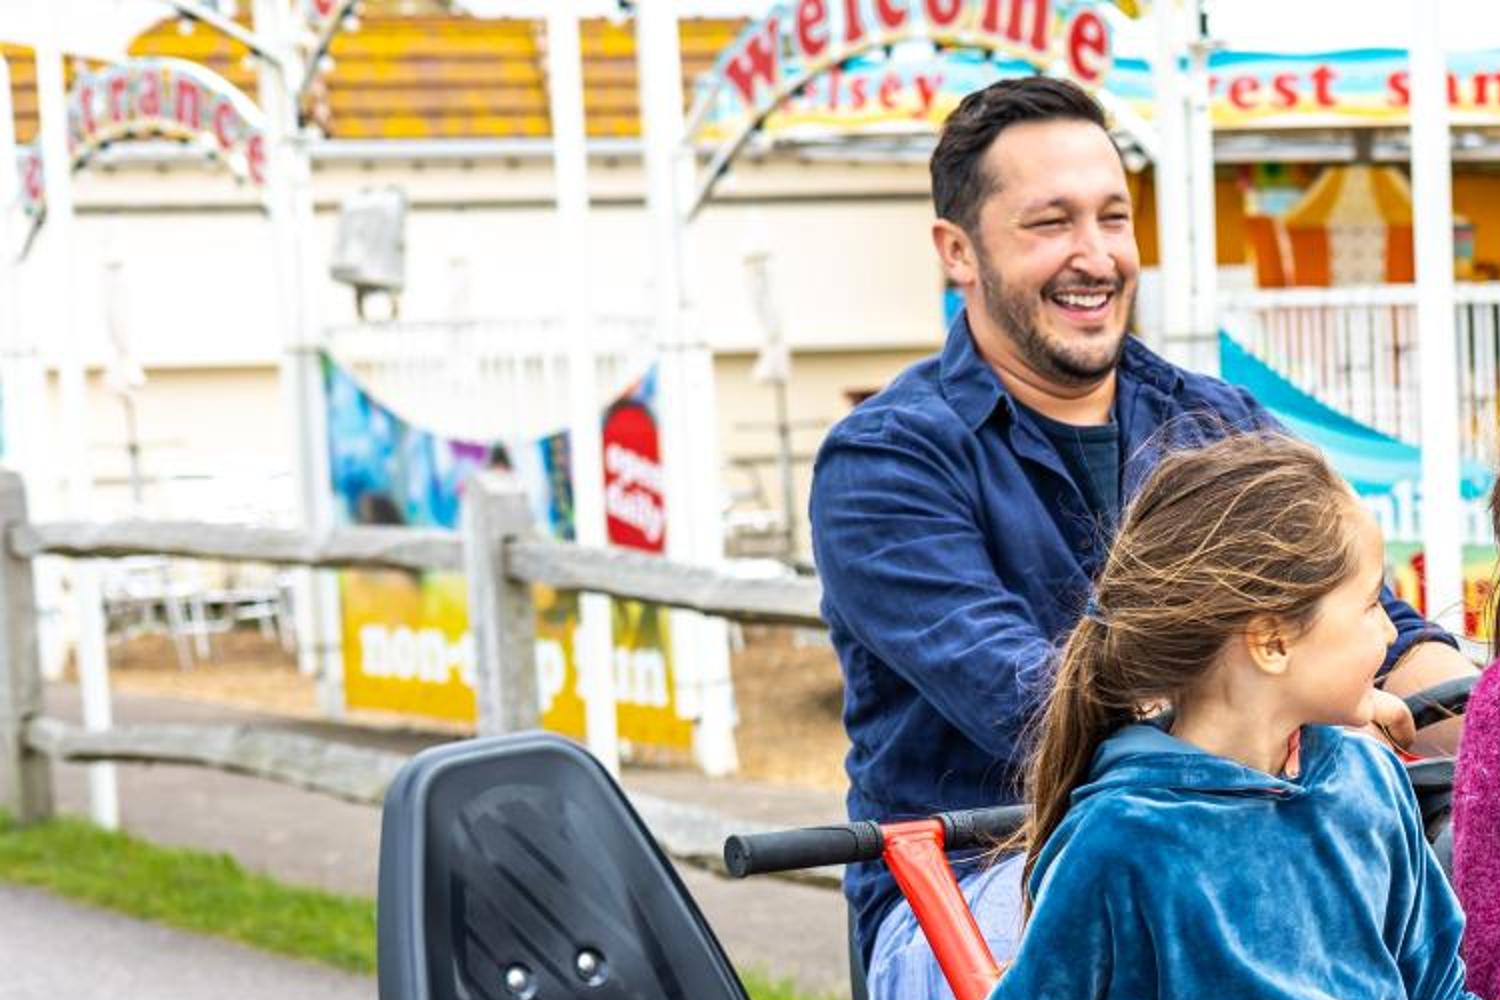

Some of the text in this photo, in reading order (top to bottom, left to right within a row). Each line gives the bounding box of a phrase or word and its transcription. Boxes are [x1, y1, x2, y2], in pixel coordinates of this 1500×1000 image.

[778, 64, 945, 119] lsey
[1208, 64, 1338, 109] est
[358, 622, 567, 714] non-p
